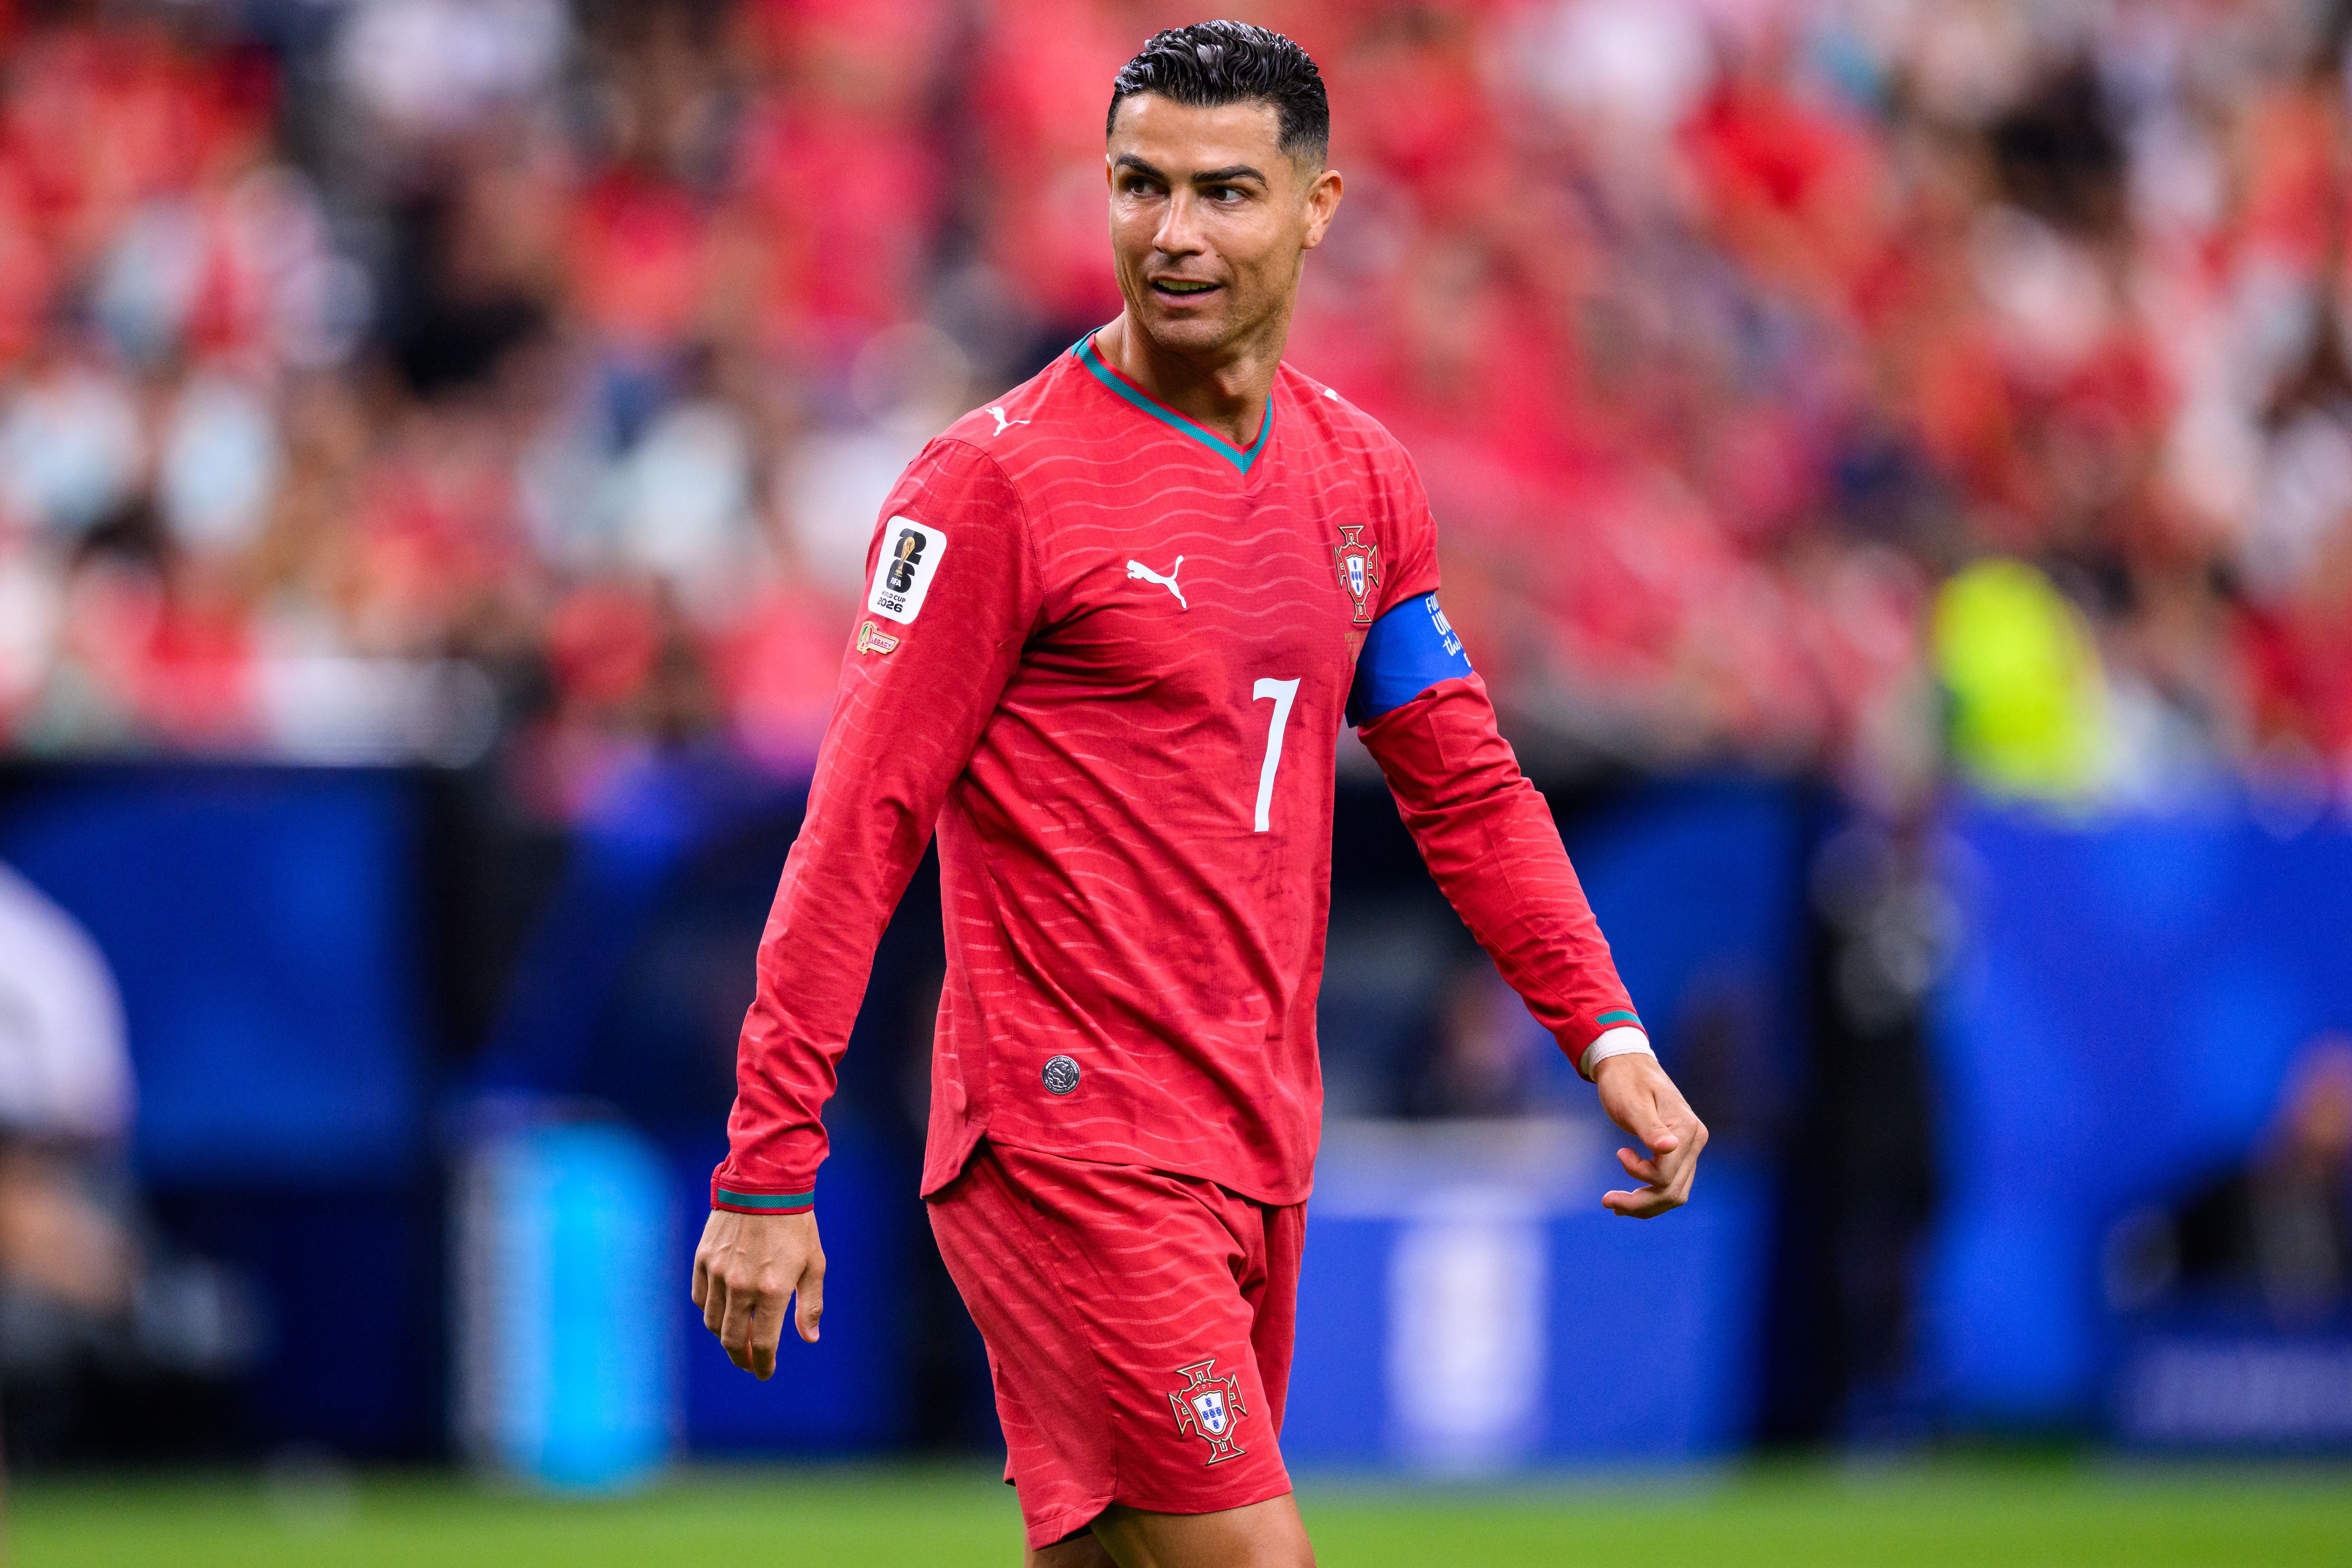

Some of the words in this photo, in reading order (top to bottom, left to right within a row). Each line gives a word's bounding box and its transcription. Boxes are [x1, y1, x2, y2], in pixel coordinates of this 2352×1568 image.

[890, 577, 901, 587] FIFA
[882, 590, 893, 598] WORLD
[877, 597, 903, 613] 2026
[872, 637, 892, 648] LEGACY
[1443, 636, 1461, 656] the
[1253, 677, 1301, 832] 7
[1195, 1383, 1213, 1393] F.P.F.
